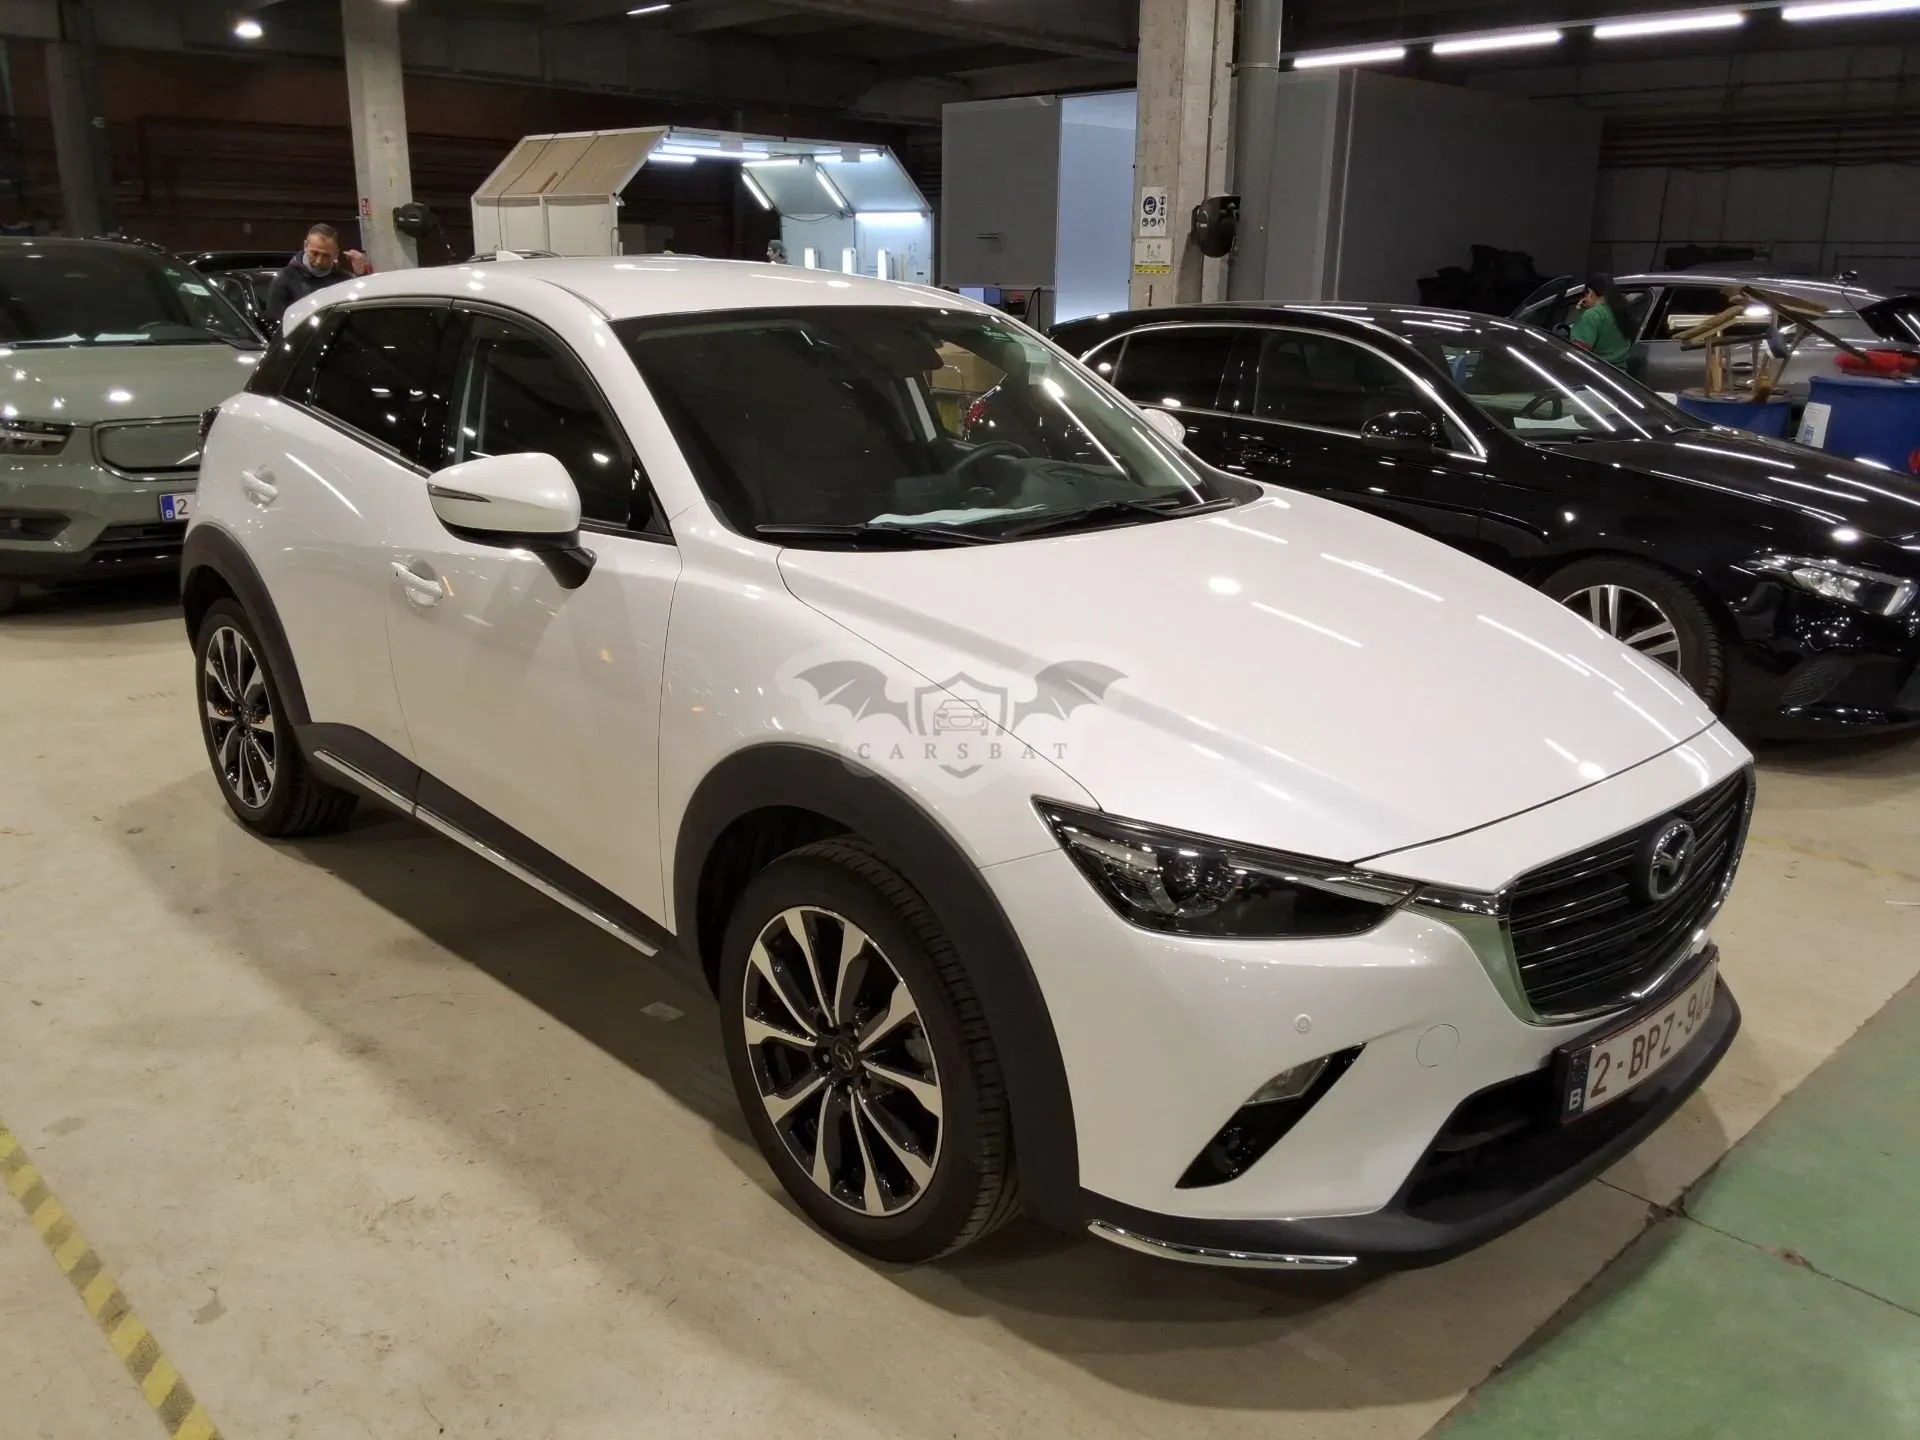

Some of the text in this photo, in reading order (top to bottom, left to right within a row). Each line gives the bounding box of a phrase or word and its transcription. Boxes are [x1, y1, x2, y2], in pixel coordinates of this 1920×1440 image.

[166, 509, 174, 518] B
[176, 498, 188, 515] 2
[1568, 1088, 1582, 1110] B
